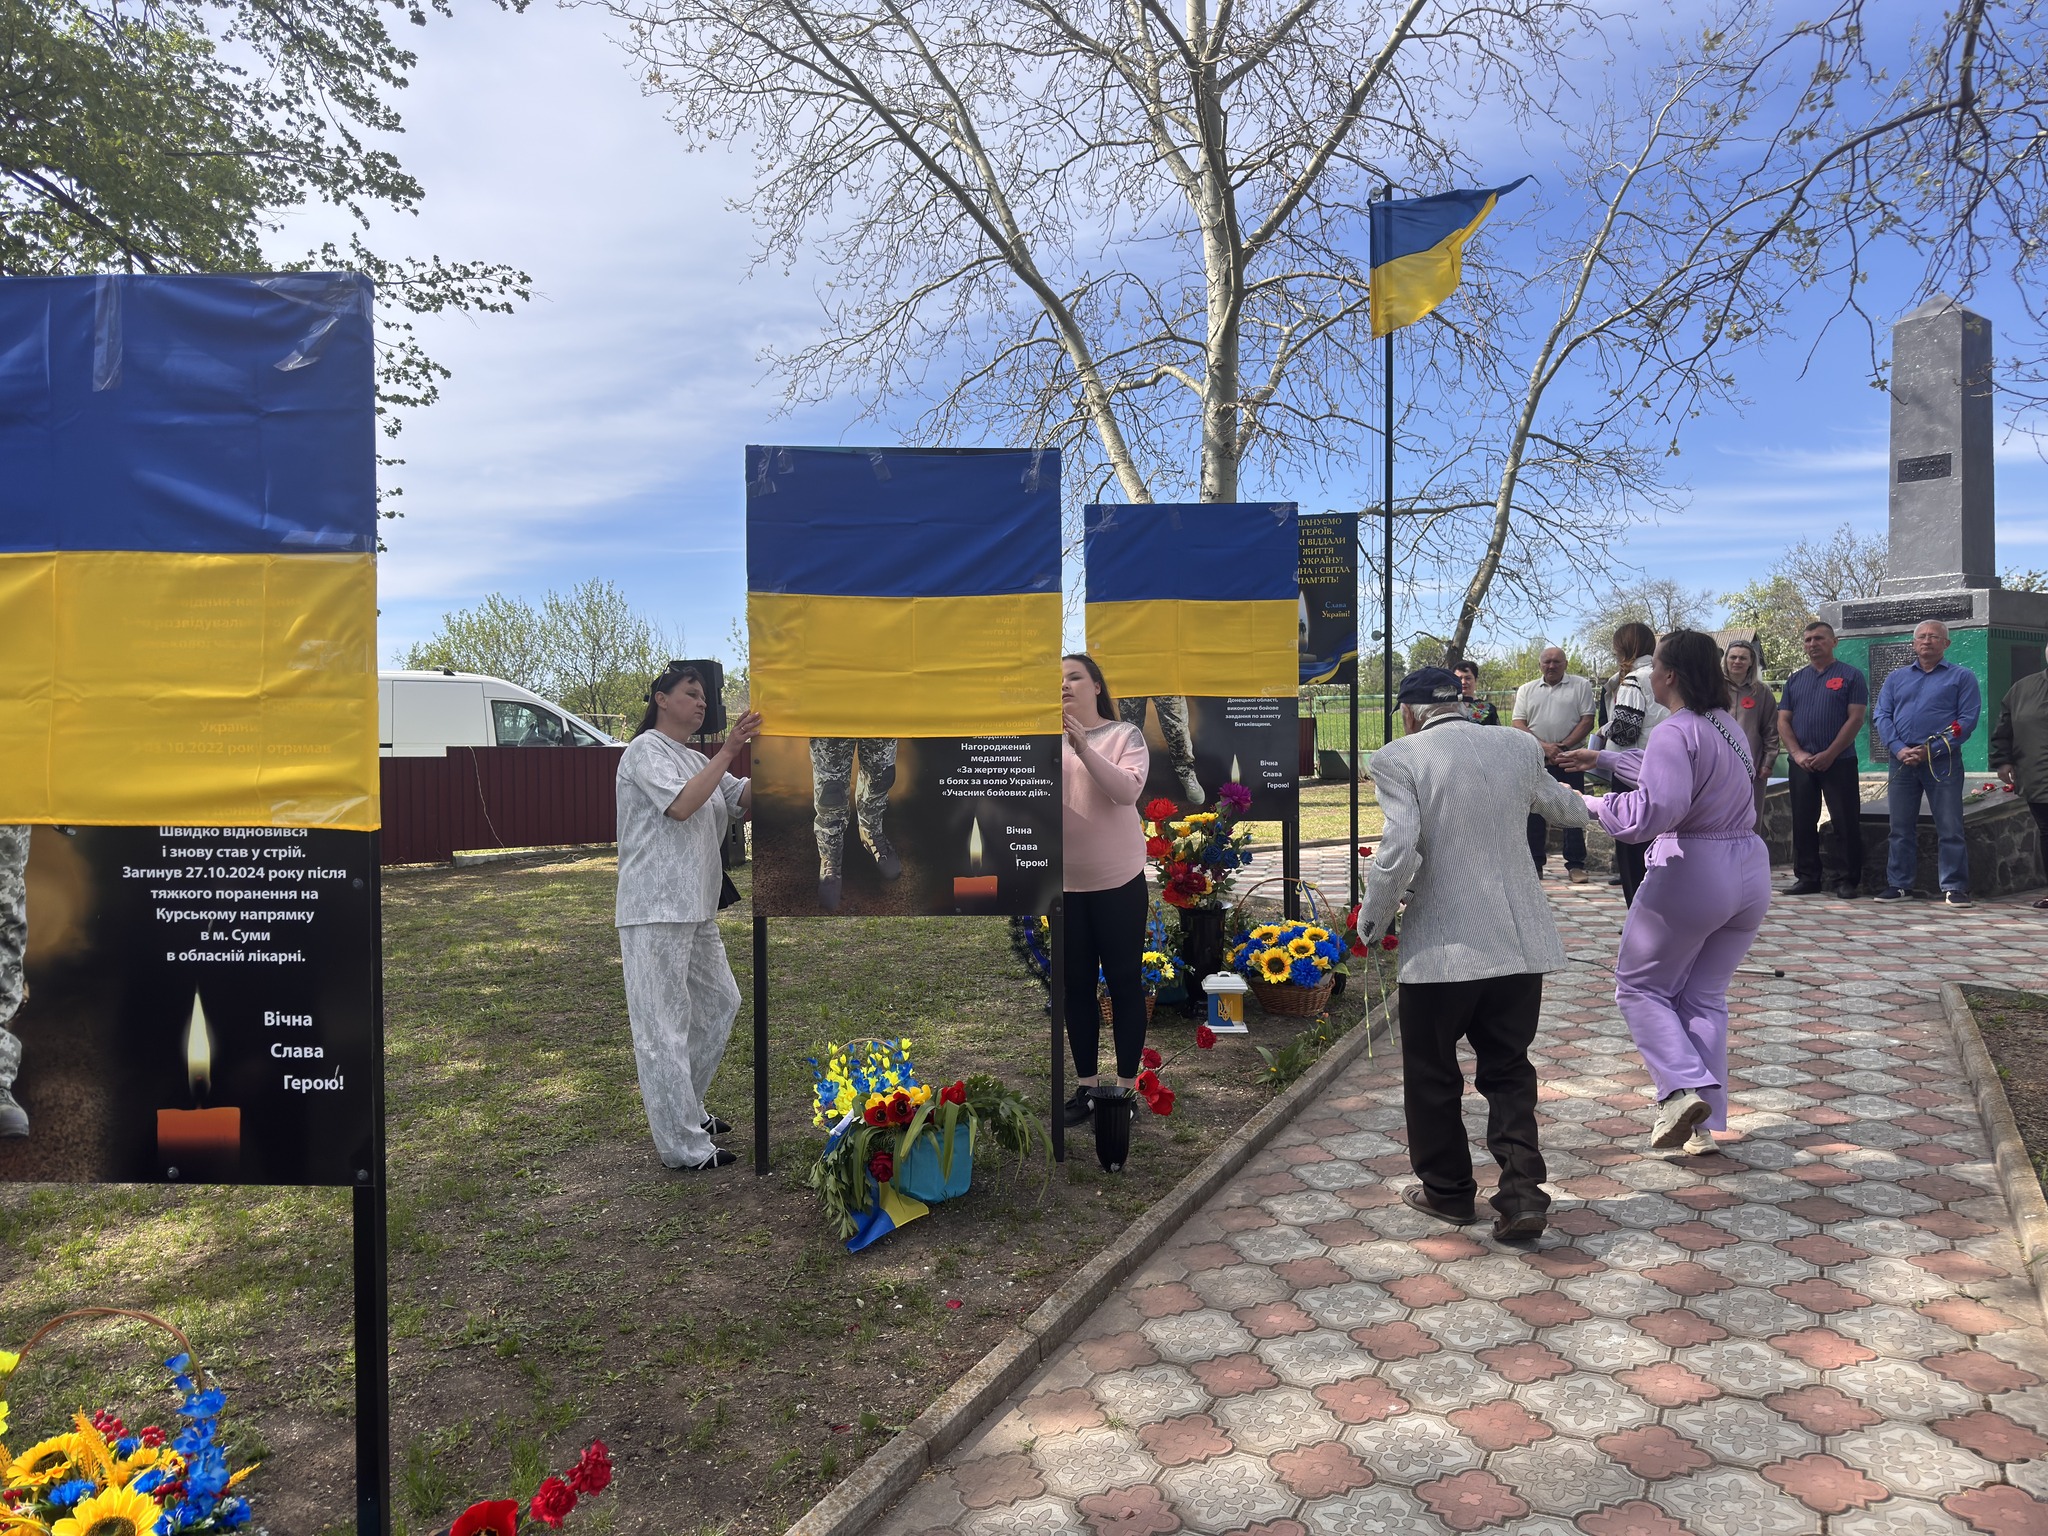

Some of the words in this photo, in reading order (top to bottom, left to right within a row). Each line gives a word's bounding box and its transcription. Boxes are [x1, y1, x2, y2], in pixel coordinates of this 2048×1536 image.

[961, 743, 1031, 752] Нагороджений
[1010, 766, 1035, 775] крові
[1009, 778, 1053, 786] України»,
[1028, 789, 1050, 797] дій».
[160, 826, 219, 839] Швидко
[223, 825, 307, 839] відновився
[1007, 826, 1032, 834] Вічна
[163, 846, 166, 857] і
[170, 849, 213, 860] знову
[217, 849, 248, 857] став
[252, 849, 260, 860] у
[264, 846, 305, 860] стрій.
[1016, 858, 1048, 869] Герою!
[123, 866, 182, 881] Загинув
[186, 867, 265, 878] 27.10.2024
[269, 870, 304, 881] року
[308, 867, 346, 878] після
[151, 890, 212, 899] тяжкого
[216, 890, 297, 902] поранення
[301, 891, 318, 899] на
[157, 908, 237, 924] Курському
[241, 911, 314, 923] напрямку
[201, 932, 209, 940] в
[213, 932, 228, 940] м.
[232, 929, 270, 943] Суми
[167, 952, 175, 961] в
[179, 949, 244, 961] обласній
[248, 950, 305, 964] лікарні.
[265, 1011, 312, 1026] Вічна
[271, 1043, 323, 1058] Слава
[284, 1073, 343, 1093] Герою!
